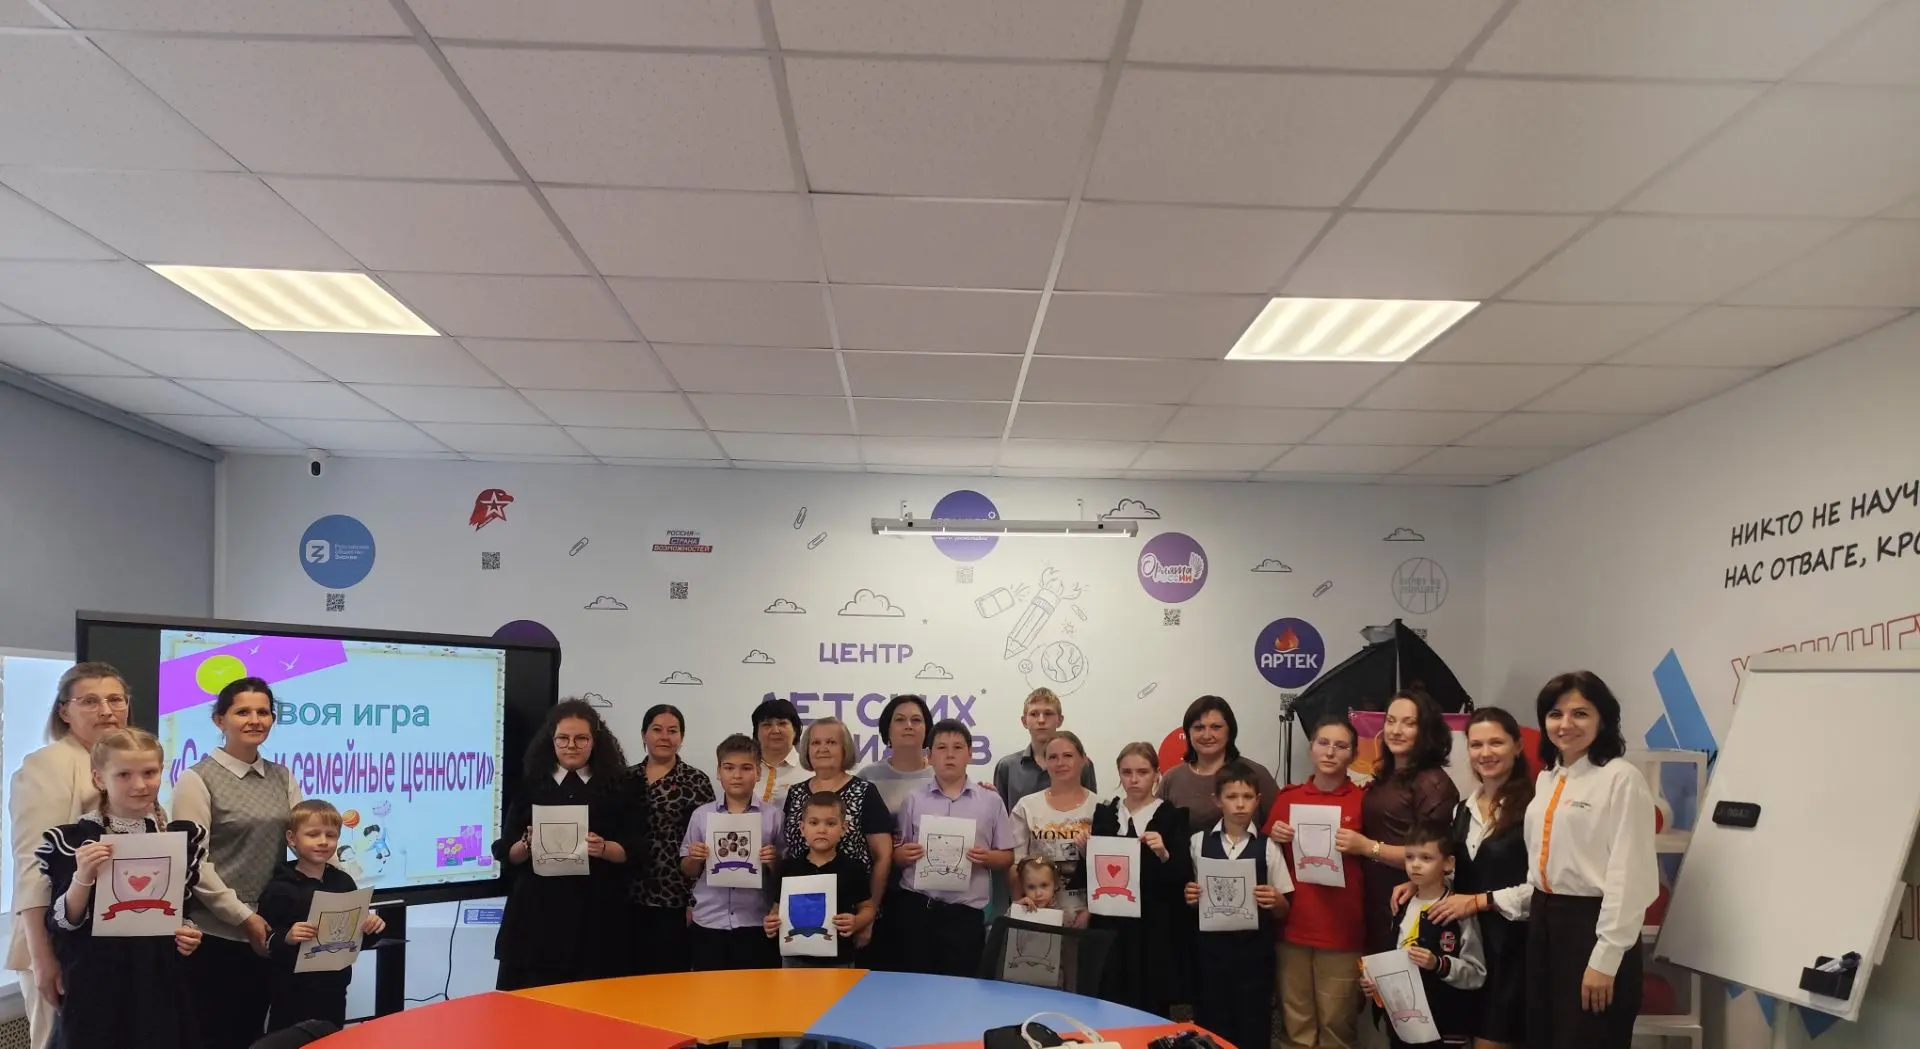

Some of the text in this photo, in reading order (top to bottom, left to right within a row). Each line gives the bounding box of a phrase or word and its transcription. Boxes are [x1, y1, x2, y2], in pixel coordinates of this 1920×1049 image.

[1731, 479, 1919, 547] НИКТО НЕ НАУЧ
[1724, 561, 1764, 589] НАС
[1770, 543, 1867, 580] ОТВАГЕ,
[819, 642, 914, 665] ЦЕНТР
[1260, 653, 1318, 669] АРТЕК
[276, 702, 430, 734] воя игра
[761, 691, 977, 728] ЕТСИХ
[292, 738, 495, 803] семейные ценности»
